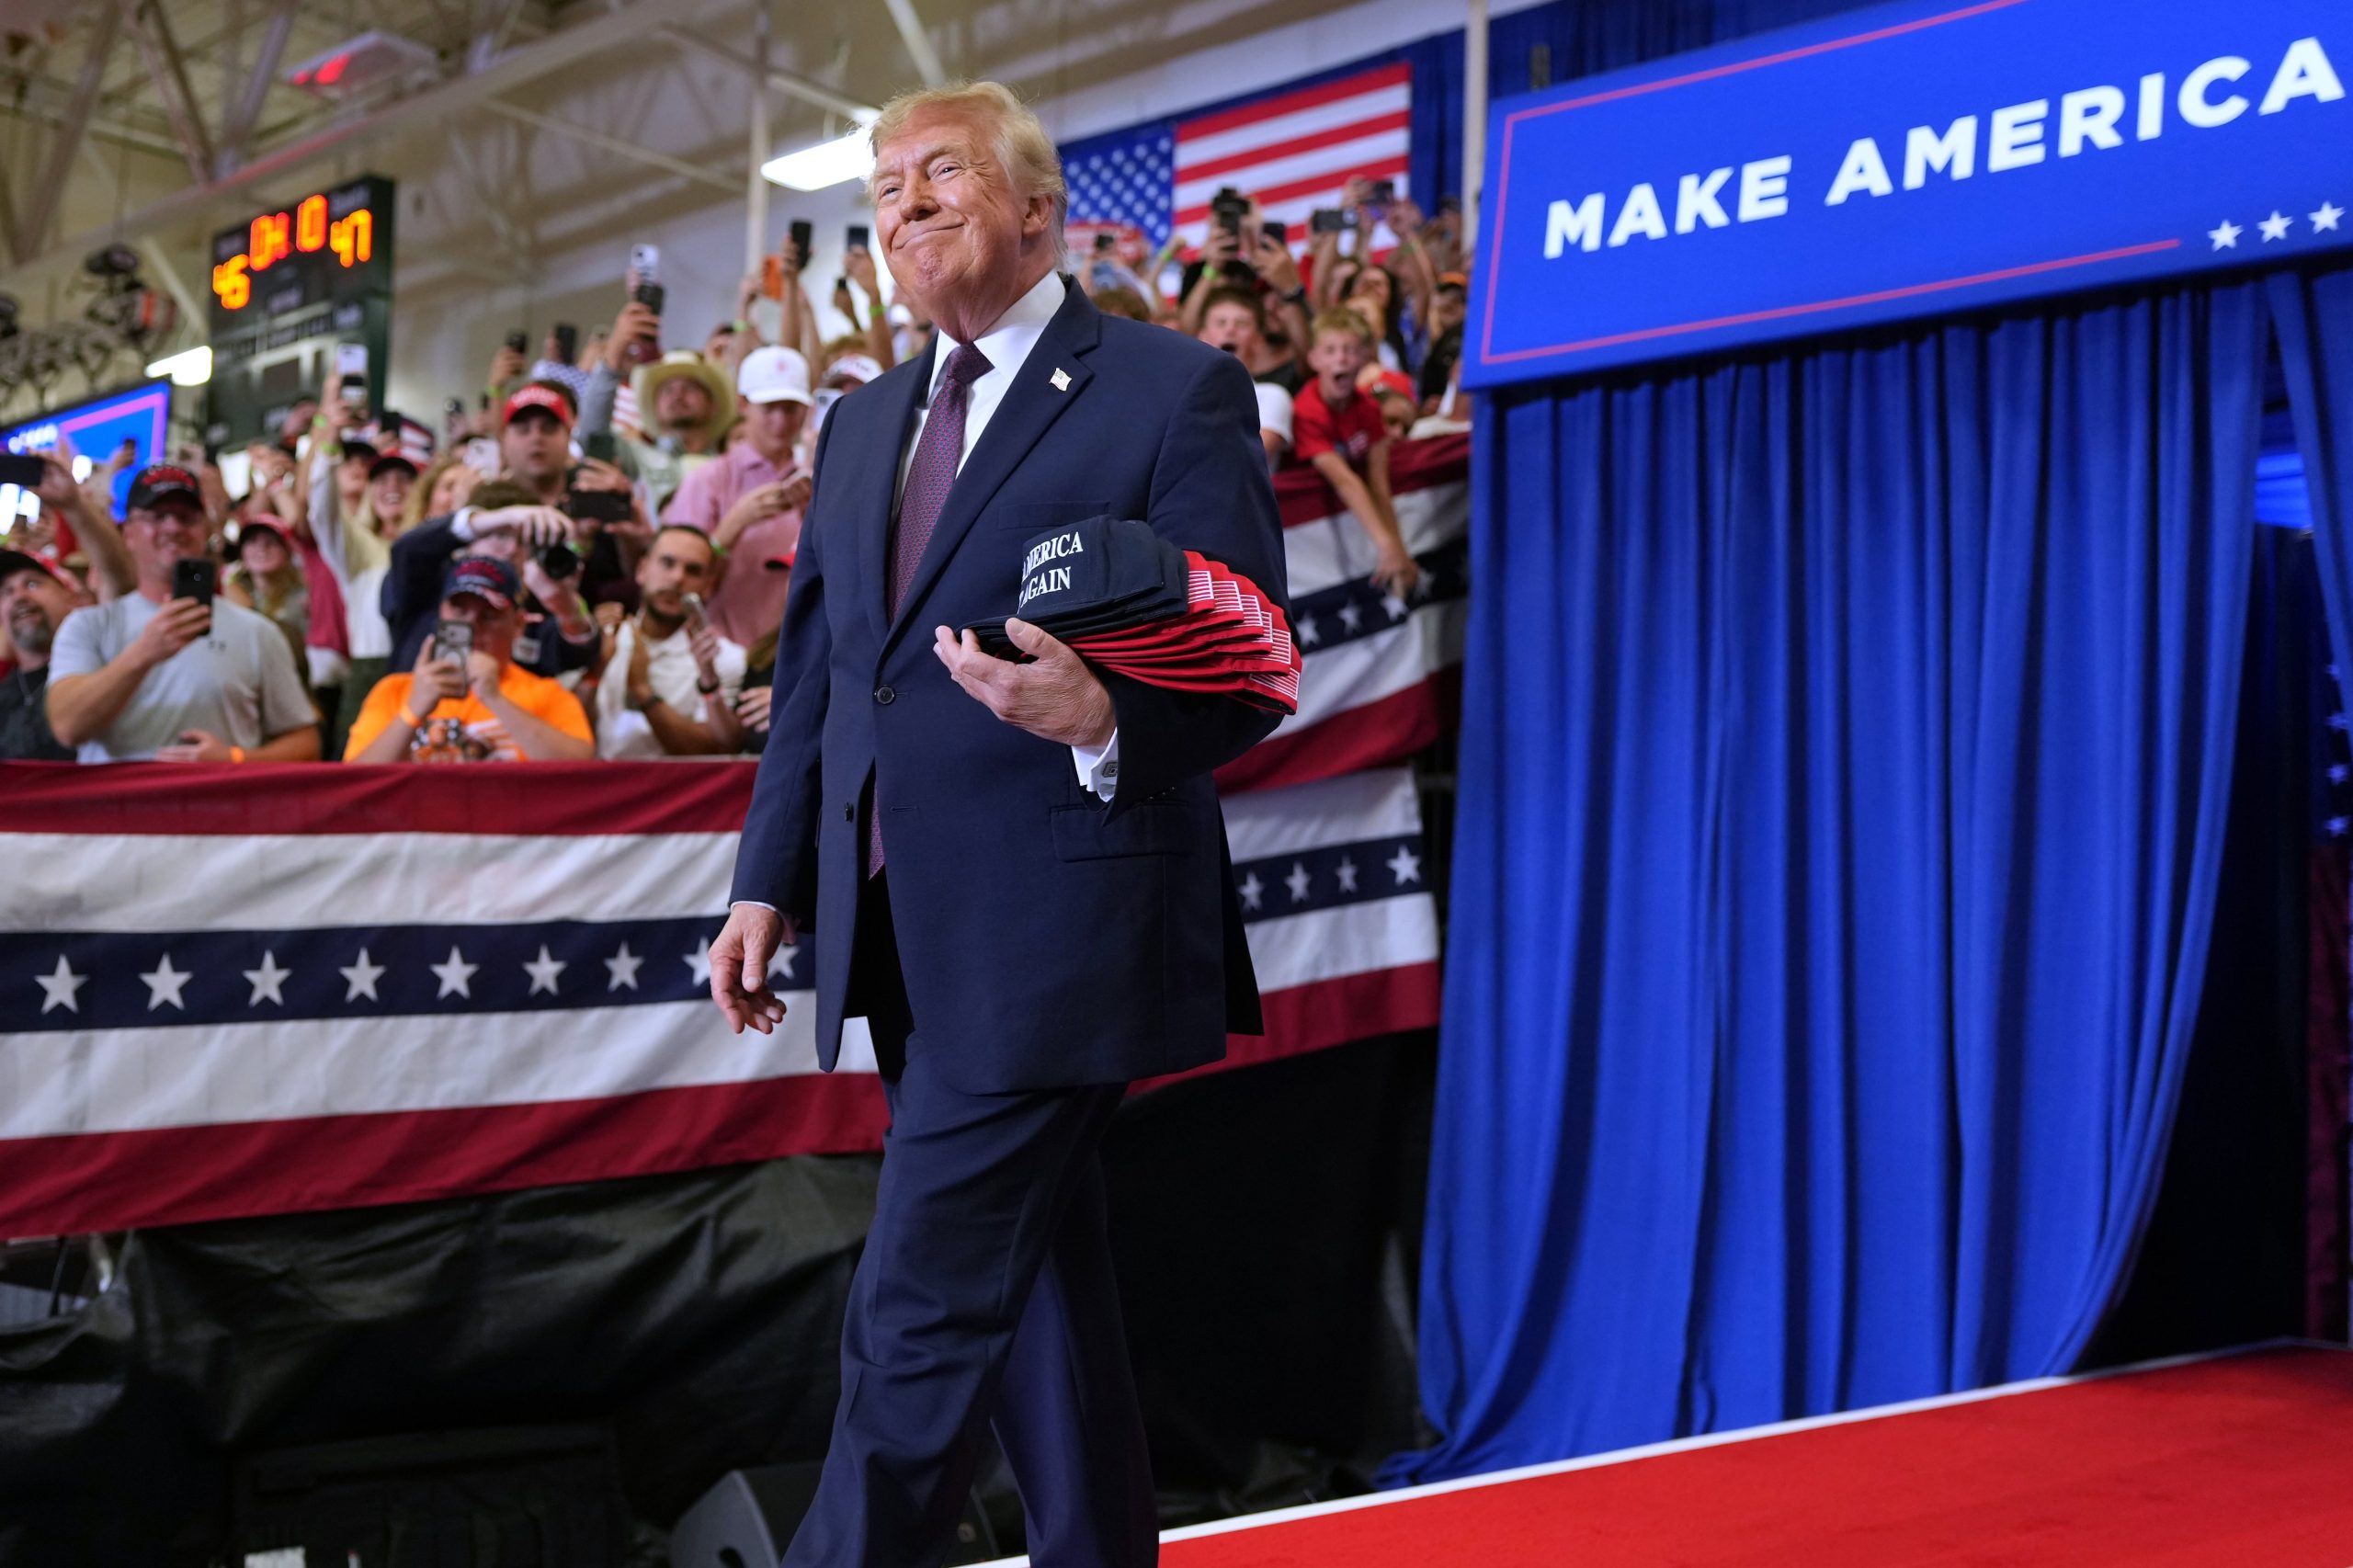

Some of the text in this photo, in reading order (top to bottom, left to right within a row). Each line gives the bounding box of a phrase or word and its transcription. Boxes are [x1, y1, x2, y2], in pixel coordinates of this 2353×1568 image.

[1544, 37, 2346, 259] MAKE AMERICA
[330, 209, 372, 267] 47
